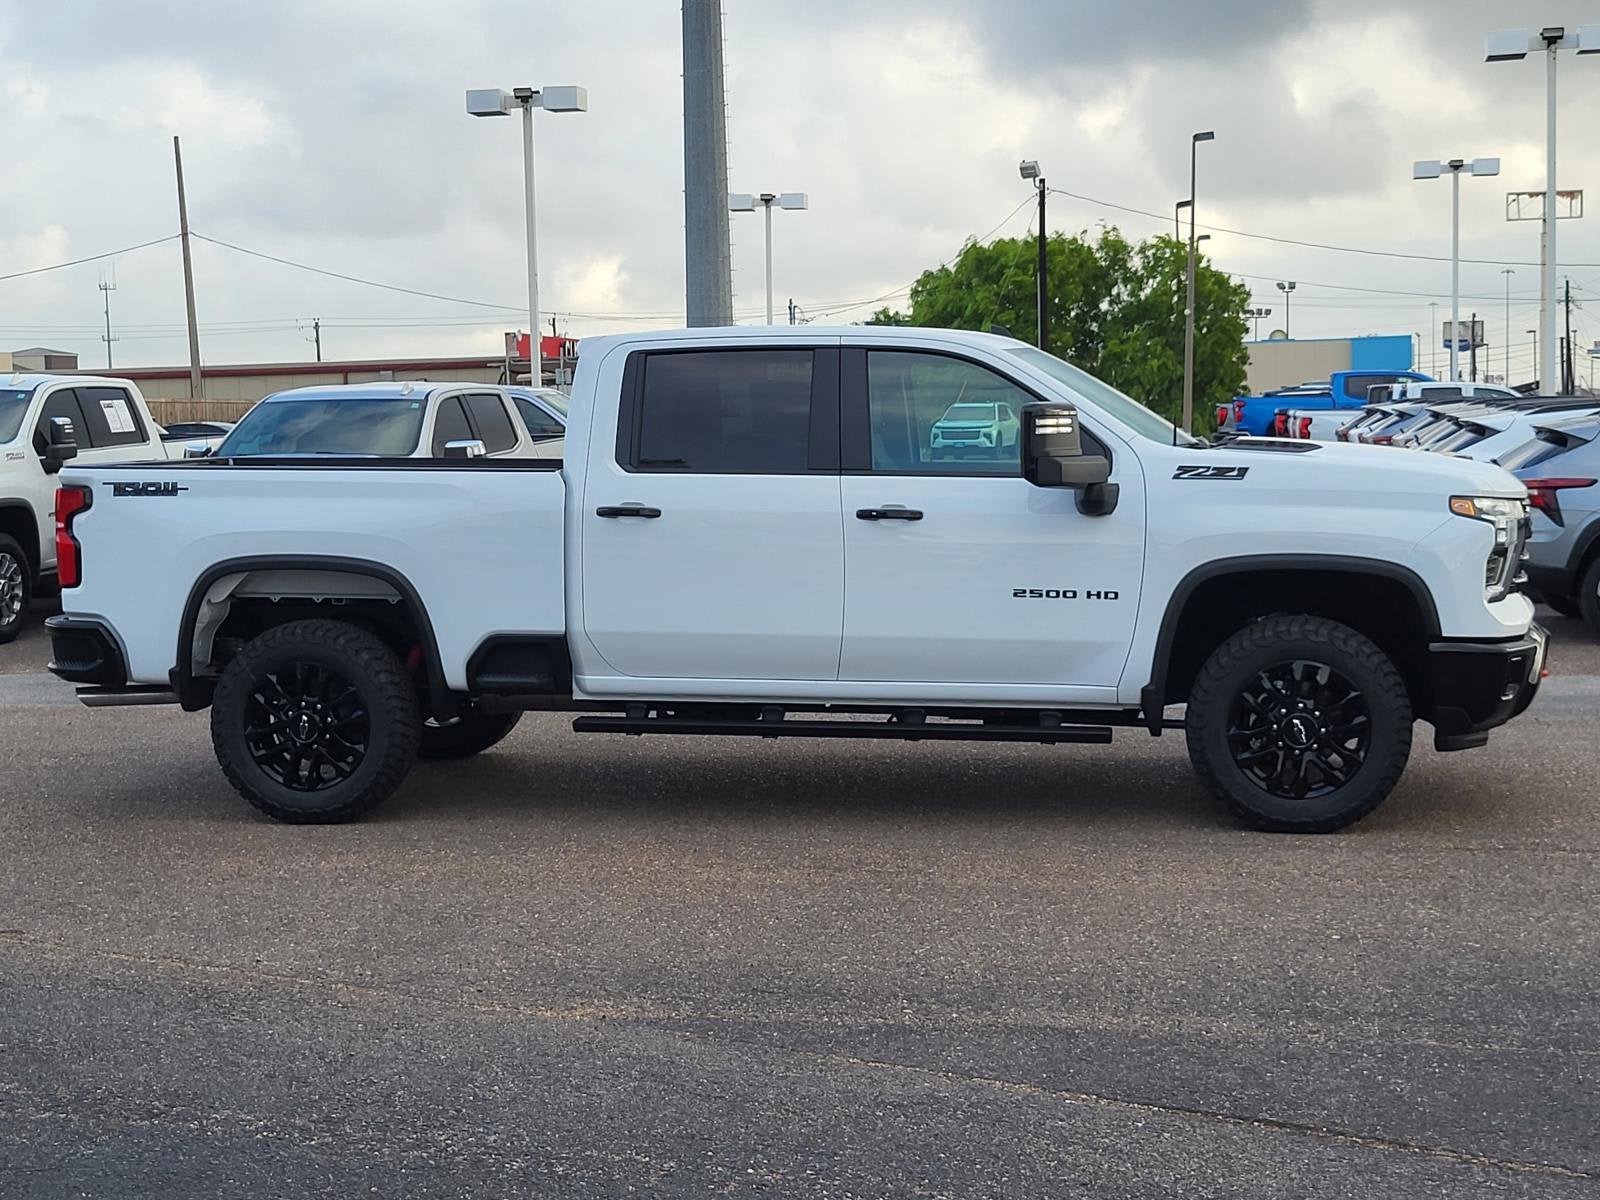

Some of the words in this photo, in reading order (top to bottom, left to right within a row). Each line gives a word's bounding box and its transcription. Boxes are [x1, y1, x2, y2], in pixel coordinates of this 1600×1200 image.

[1172, 465, 1250, 480] Z71
[1013, 588, 1077, 599] 2500
[1086, 590, 1119, 600] HD
